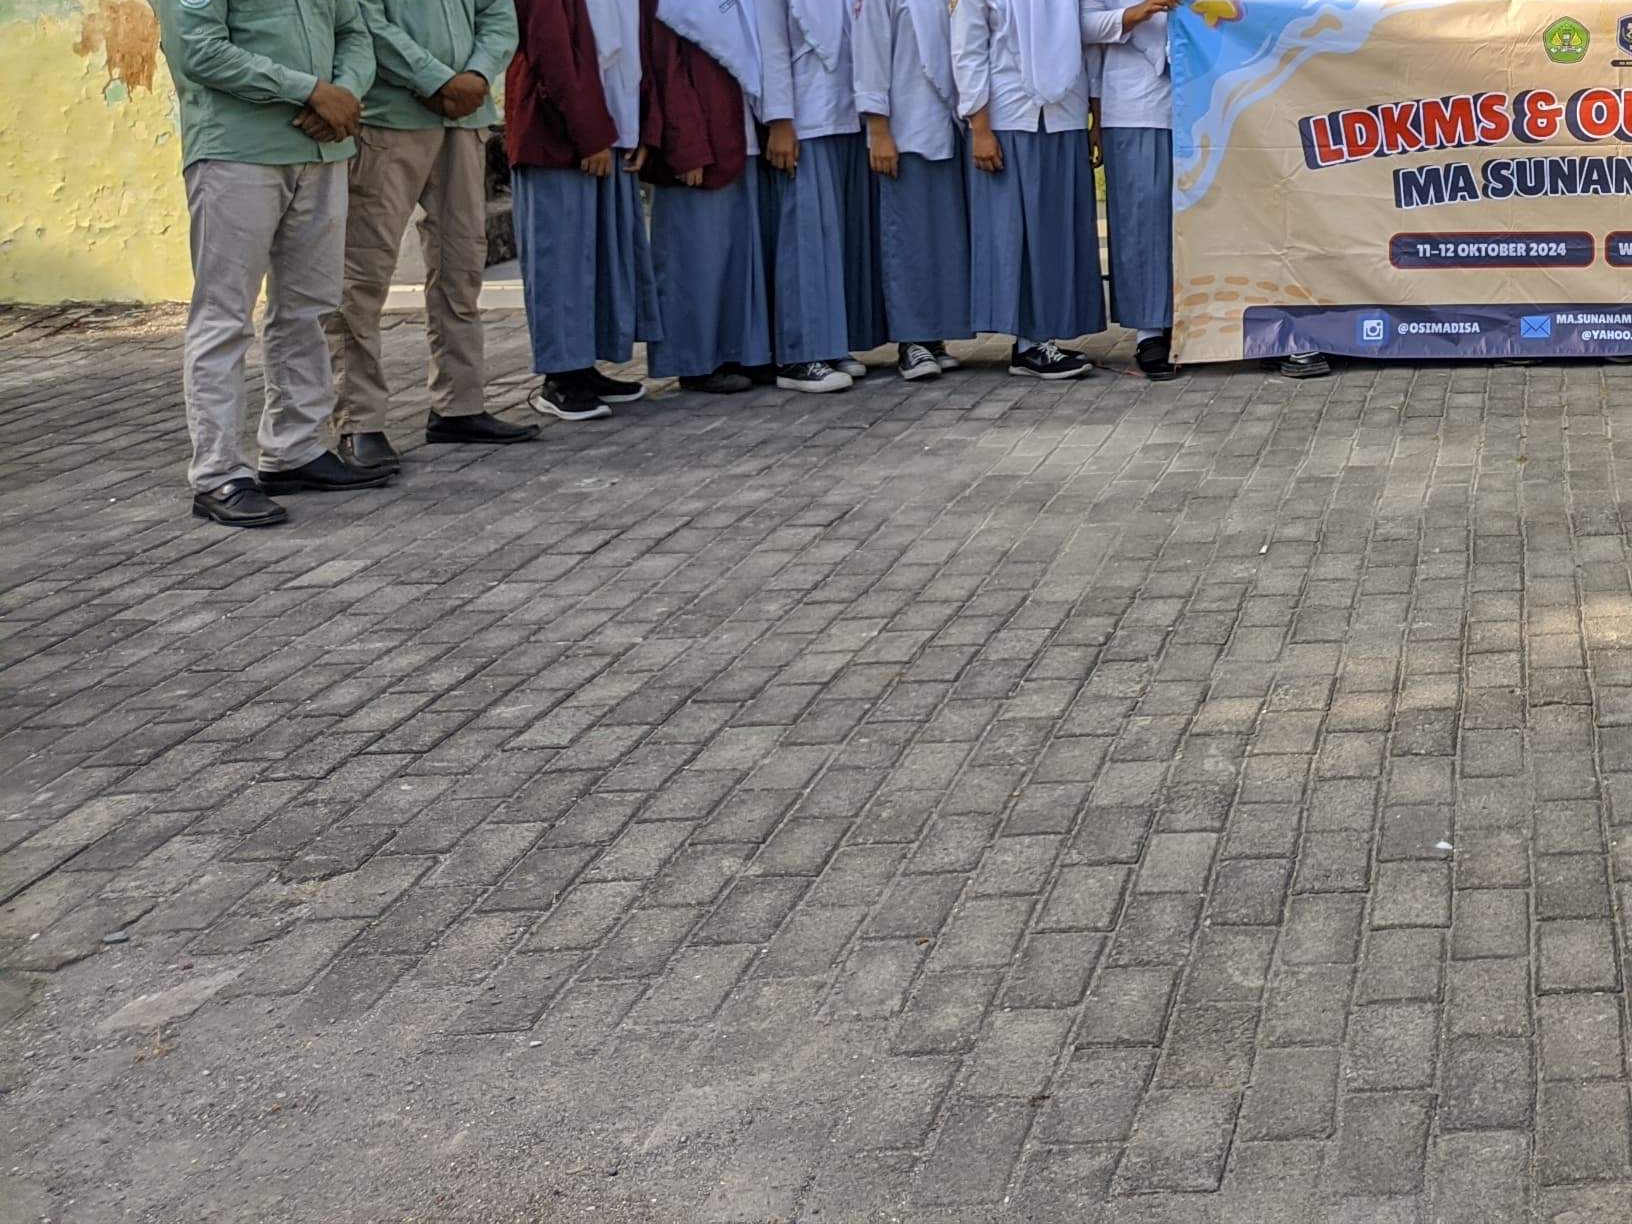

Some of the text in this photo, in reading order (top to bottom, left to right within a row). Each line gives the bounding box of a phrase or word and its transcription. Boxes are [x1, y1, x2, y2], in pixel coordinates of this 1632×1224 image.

[1300, 91, 1512, 169] LDKMS
[1513, 88, 1565, 144] &
[1393, 161, 1480, 209] MA
[1457, 243, 1527, 257] OKTOBER
[1529, 242, 1567, 257] 2024
[1397, 321, 1480, 335] @OSIMADISA
